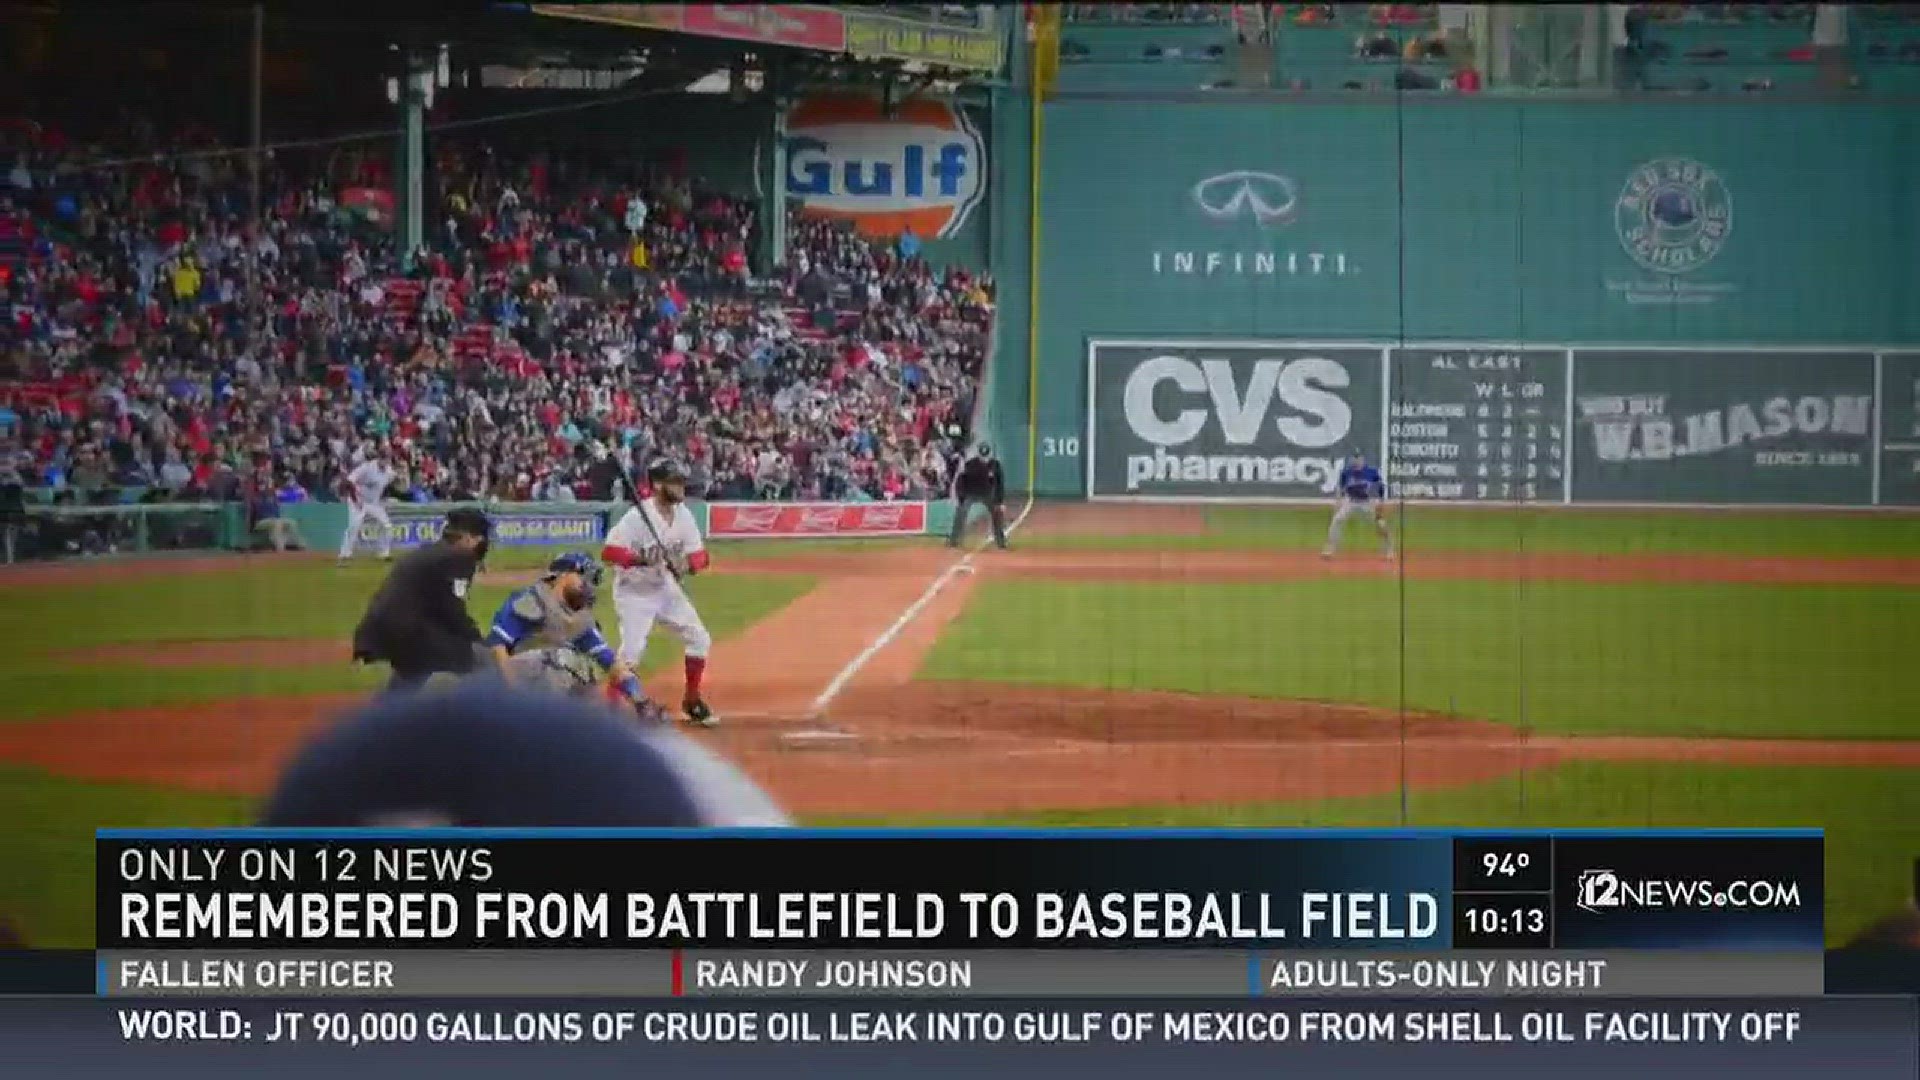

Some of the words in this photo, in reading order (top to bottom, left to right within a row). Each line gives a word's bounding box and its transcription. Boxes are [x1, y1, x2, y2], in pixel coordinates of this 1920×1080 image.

[786, 137, 967, 197] Gulf
[1153, 252, 1346, 275] INFINITI
[1123, 356, 1353, 446] CVS
[1475, 382, 1494, 398] W
[1502, 382, 1514, 398] L
[1043, 436, 1079, 456] 310
[1127, 445, 1345, 494] pharmacy
